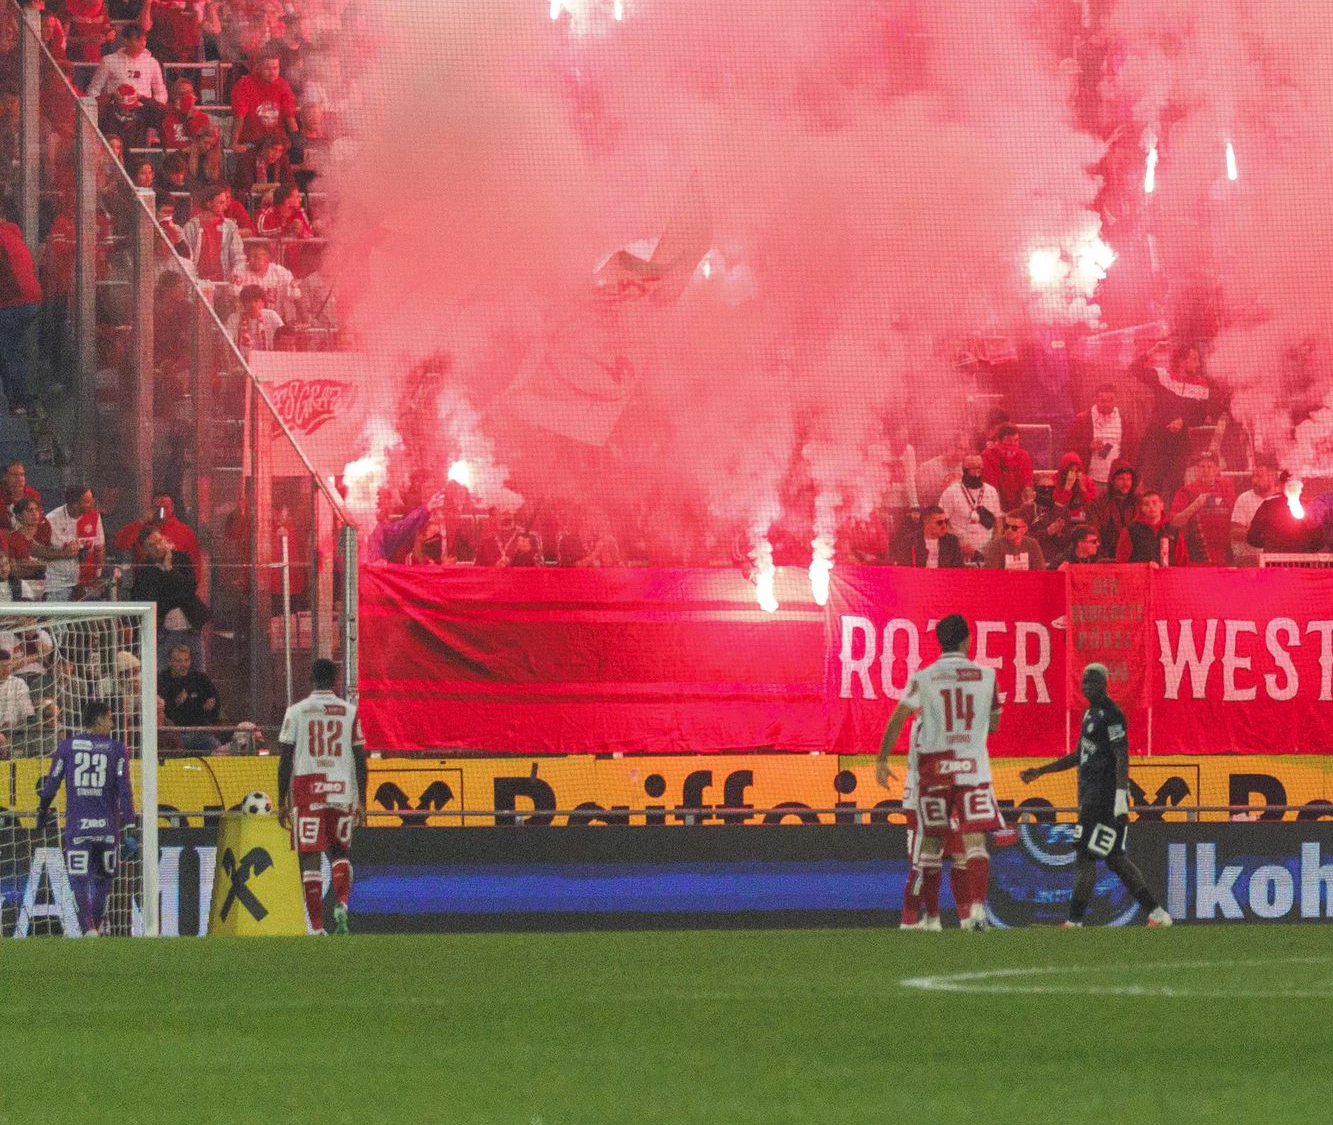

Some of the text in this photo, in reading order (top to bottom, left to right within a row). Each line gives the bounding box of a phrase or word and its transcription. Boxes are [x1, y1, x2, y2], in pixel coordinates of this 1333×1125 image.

[838, 615, 1052, 703] ROER
[939, 688, 975, 732] 14
[74, 751, 108, 787] 23
[939, 760, 972, 773] ZIRO
[314, 782, 342, 793] ZIRO
[80, 818, 106, 830] ZIRO
